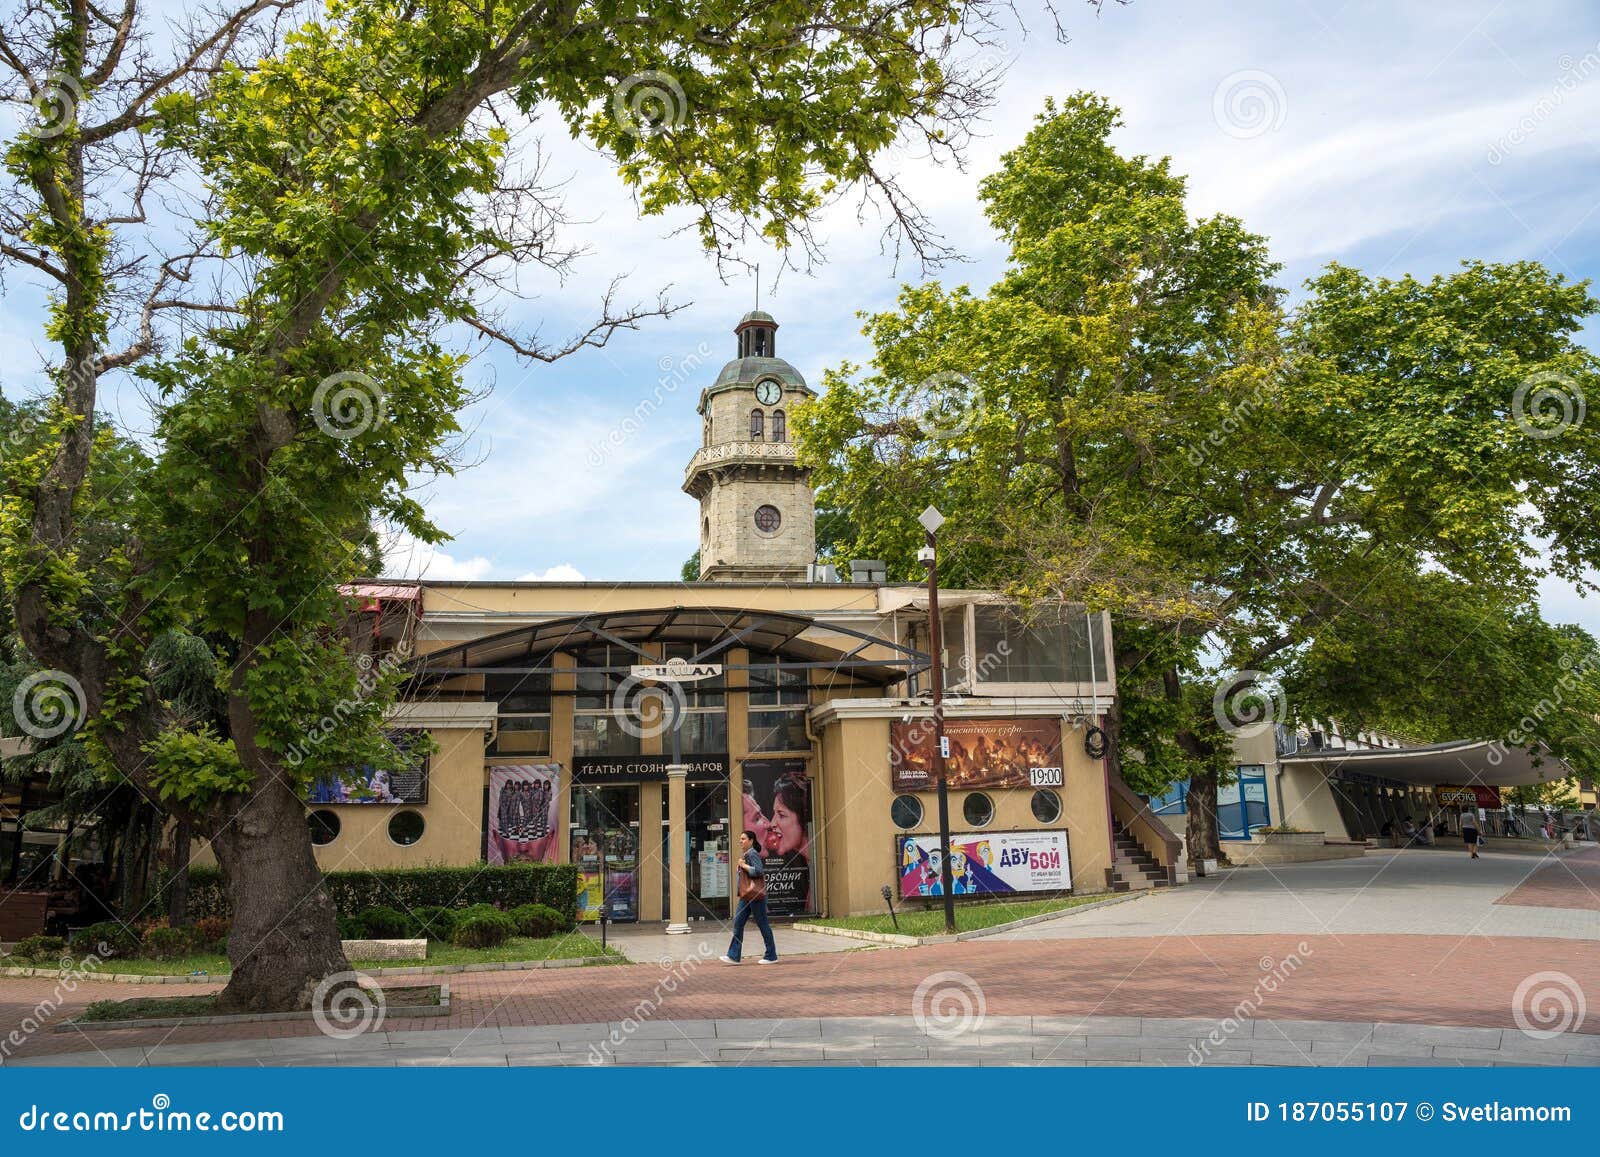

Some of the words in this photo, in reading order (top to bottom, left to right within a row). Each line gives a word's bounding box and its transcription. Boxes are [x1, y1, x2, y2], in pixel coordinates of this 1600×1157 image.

[582, 763, 623, 775] ТЕАТЪР
[626, 763, 664, 774] СТОЯН
[688, 762, 724, 772] ВАРОВ
[1031, 768, 1061, 785] 19:00
[766, 881, 796, 891] ИСМА
